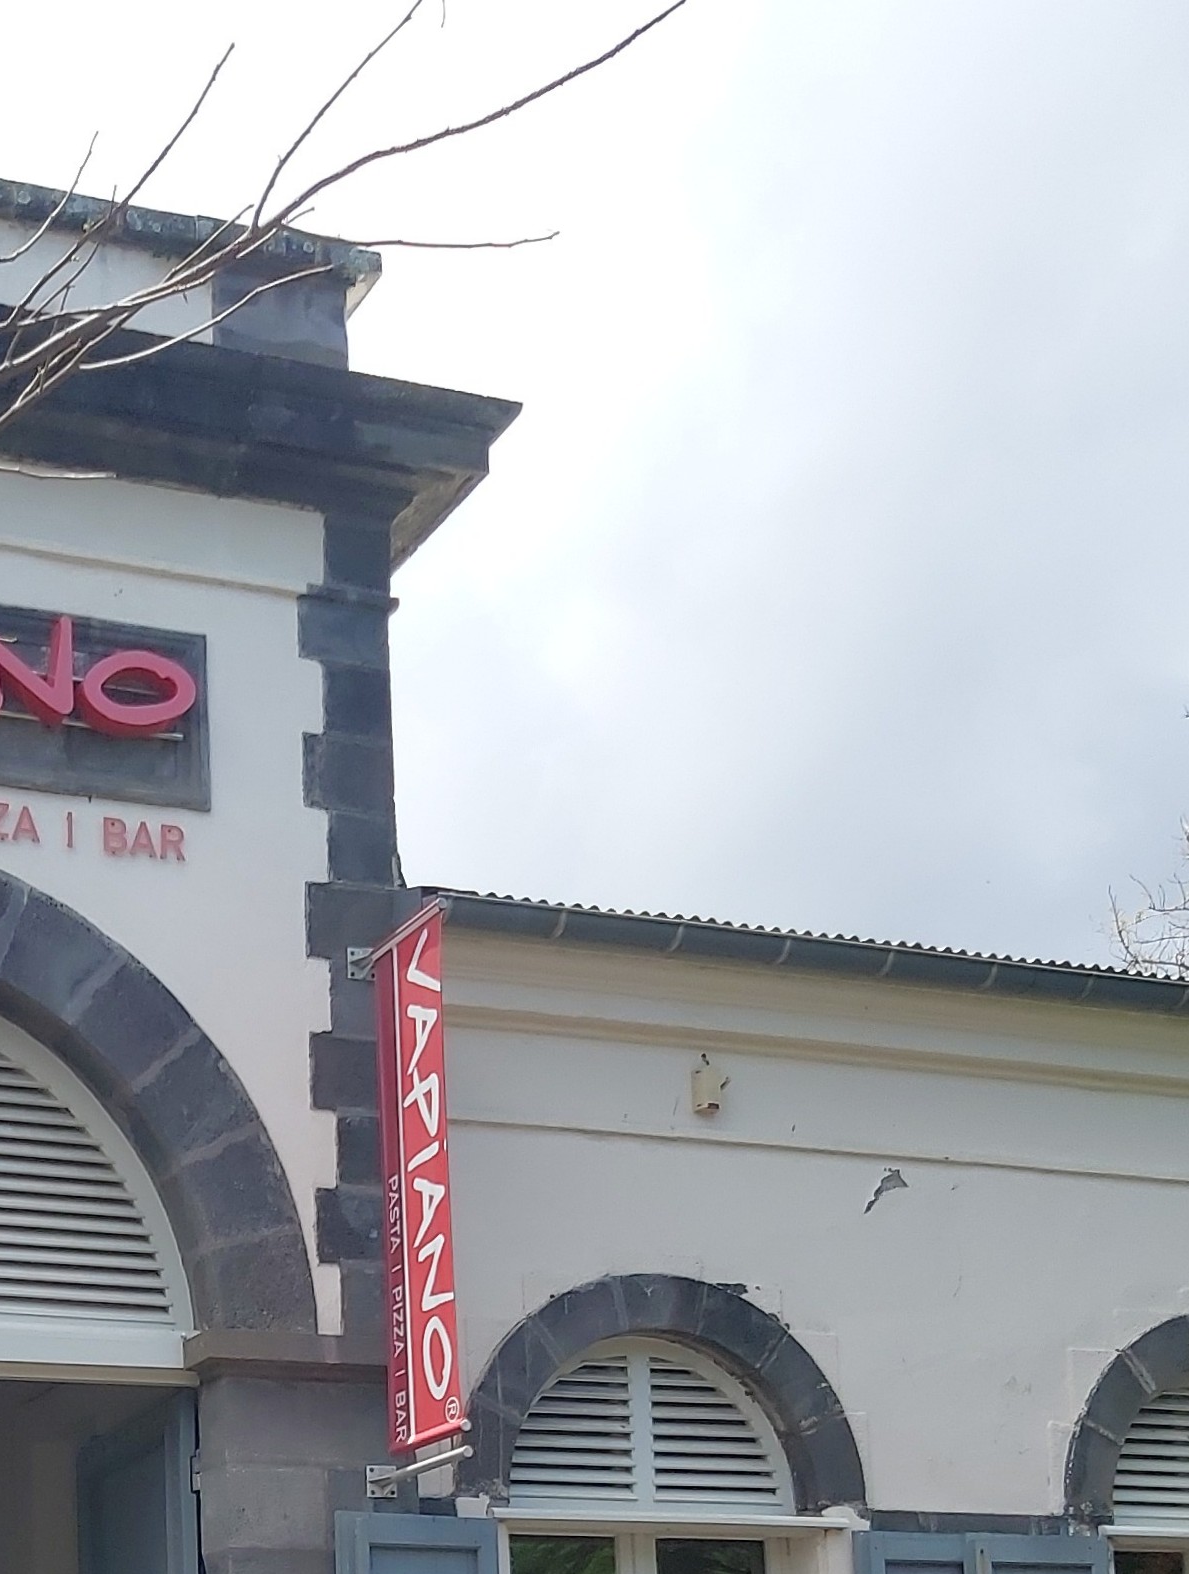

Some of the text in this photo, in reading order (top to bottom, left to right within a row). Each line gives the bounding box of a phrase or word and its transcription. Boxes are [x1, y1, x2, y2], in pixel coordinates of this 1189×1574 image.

[102, 816, 187, 862] BAR
[388, 1173, 402, 1254] PASTA
[391, 1286, 404, 1357] PIZZA
[395, 1389, 407, 1443] BAR
